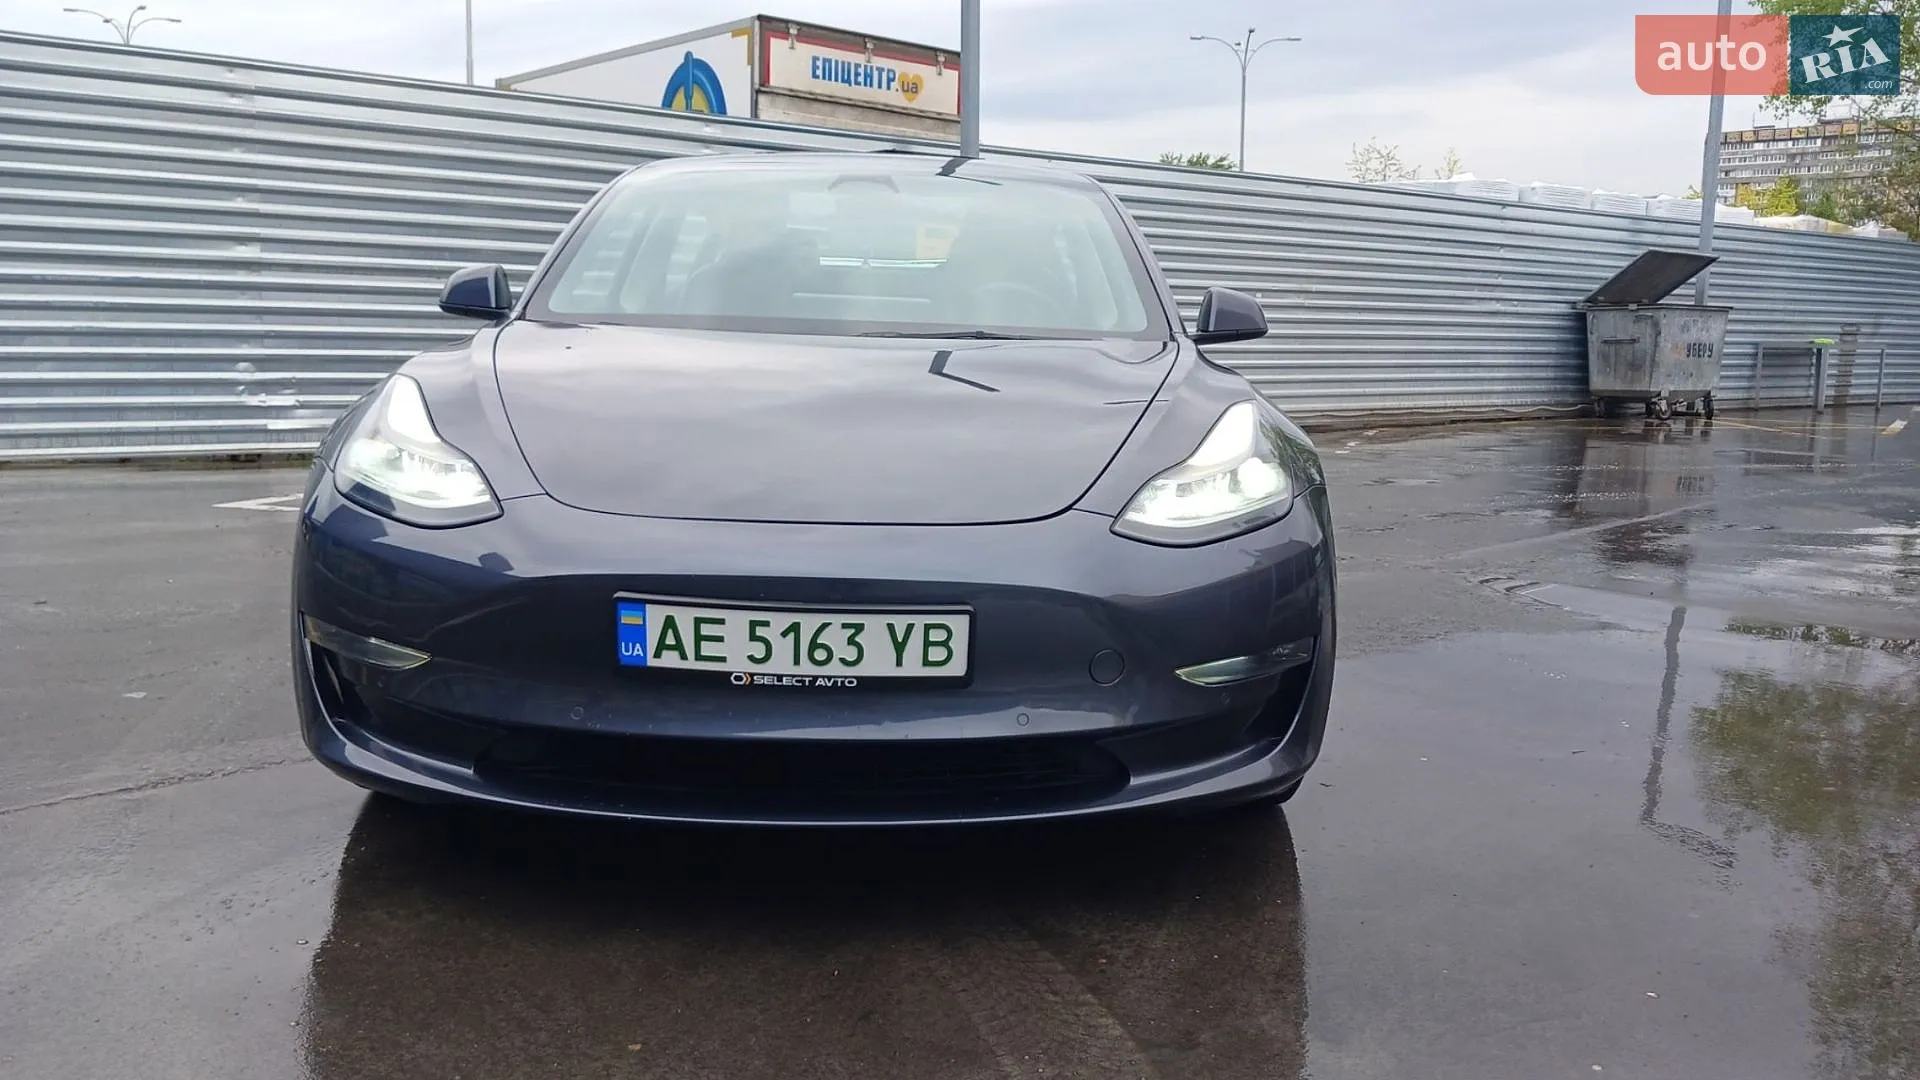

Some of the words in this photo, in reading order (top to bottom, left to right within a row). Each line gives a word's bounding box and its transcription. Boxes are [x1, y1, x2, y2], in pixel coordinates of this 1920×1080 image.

[652, 615, 727, 663] AE
[746, 619, 866, 667] 5163
[886, 622, 954, 668] YB
[621, 642, 644, 657] UA
[753, 675, 813, 687] SELECT
[815, 677, 857, 687] AVTO
